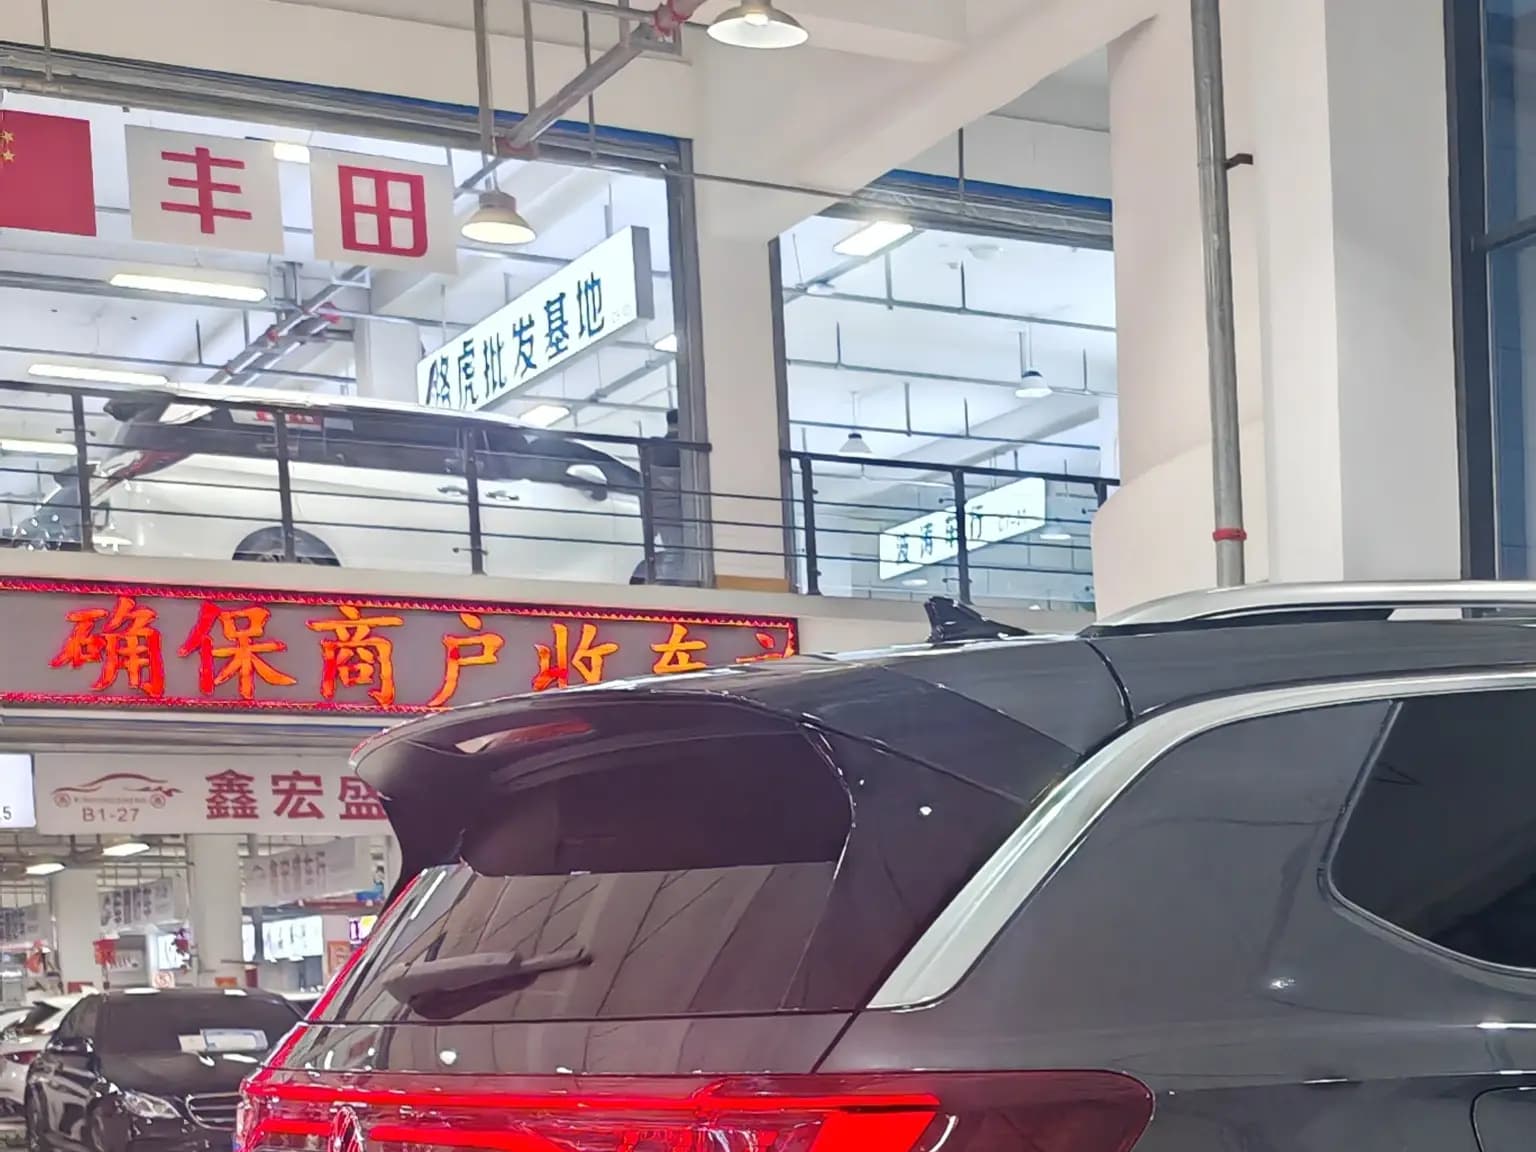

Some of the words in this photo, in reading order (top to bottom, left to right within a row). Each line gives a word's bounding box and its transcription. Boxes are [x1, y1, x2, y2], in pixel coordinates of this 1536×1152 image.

[160, 146, 428, 258] 丰田
[48, 595, 786, 707] 确保商户收车
[82, 807, 140, 823] B1-27
[204, 768, 388, 821] 鑫宏盛
